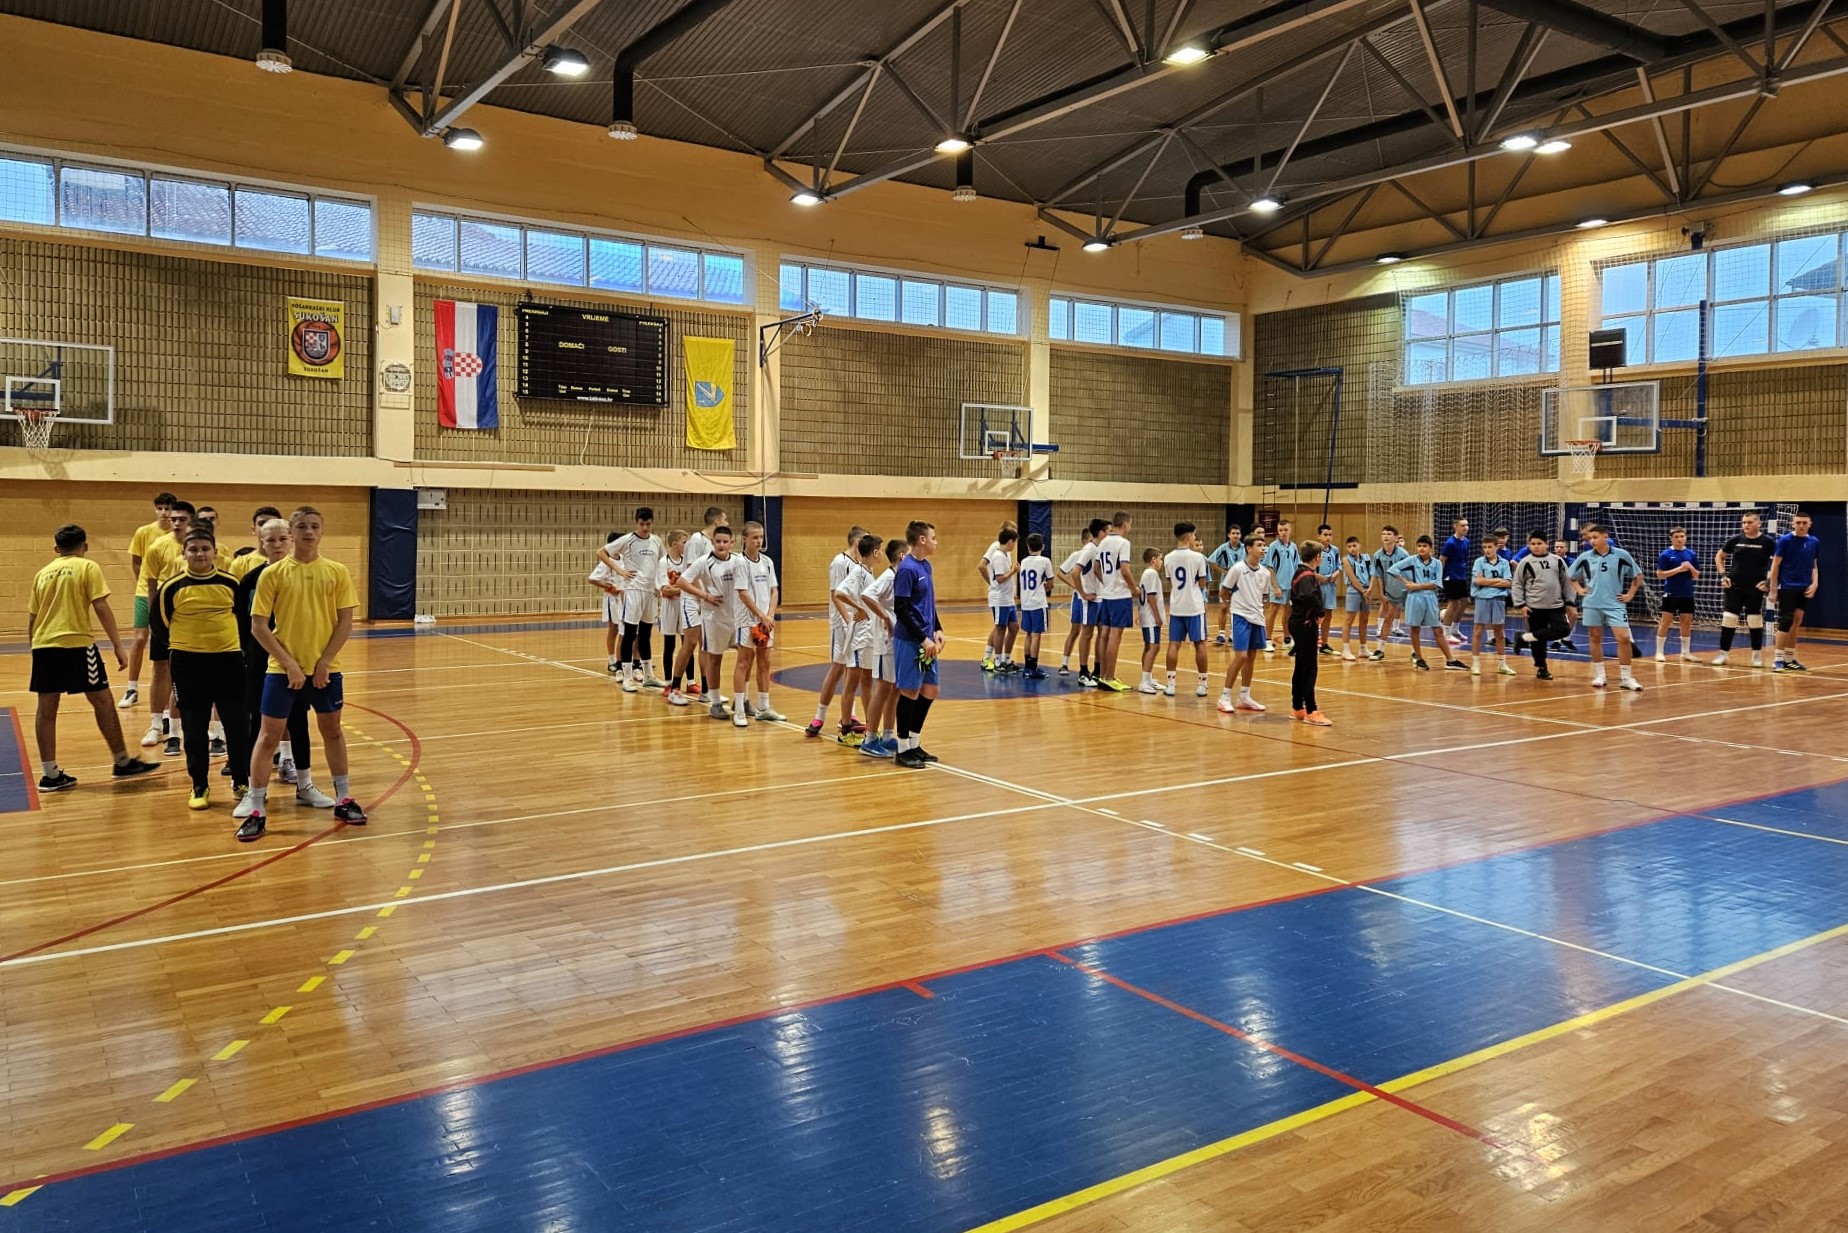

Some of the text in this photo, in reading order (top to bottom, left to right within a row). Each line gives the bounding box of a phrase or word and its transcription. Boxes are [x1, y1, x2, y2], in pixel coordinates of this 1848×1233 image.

[294, 311, 339, 324] SUKOŠAN
[558, 341, 585, 350] DOMAĆI
[607, 345, 628, 354] GOSTI
[1100, 551, 1114, 575] 15
[1539, 560, 1551, 570] 12
[1601, 562, 1608, 573] 5
[1021, 569, 1038, 591] 18
[1174, 566, 1187, 591] 9
